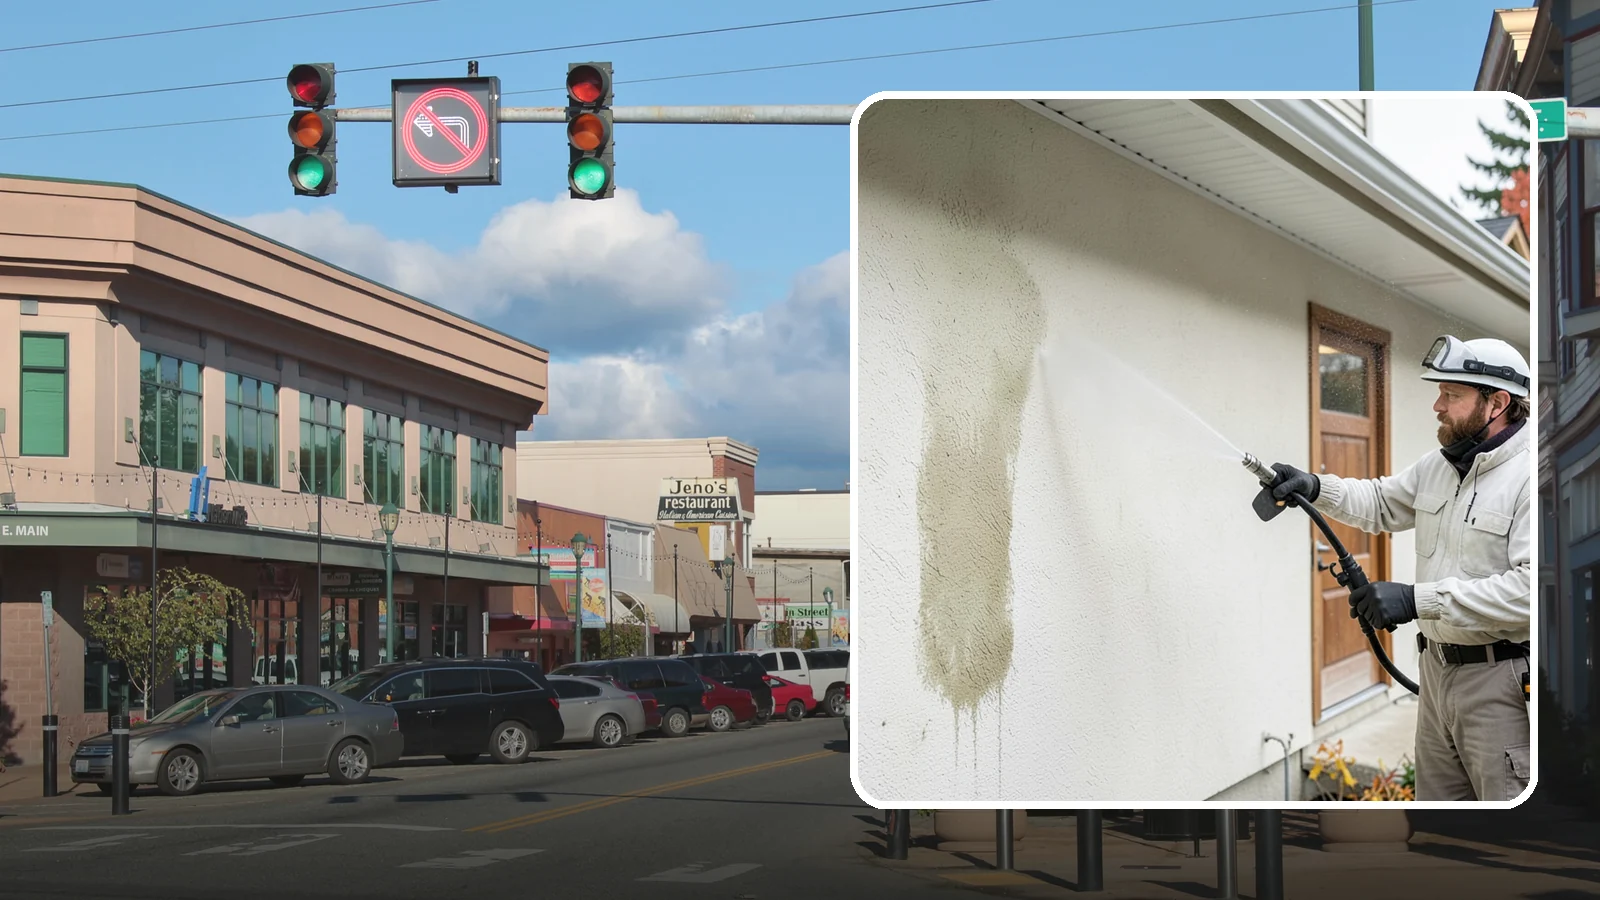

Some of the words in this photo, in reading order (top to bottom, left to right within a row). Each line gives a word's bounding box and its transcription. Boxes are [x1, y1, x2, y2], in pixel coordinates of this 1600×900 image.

[669, 479, 728, 495] Jeno's
[664, 496, 732, 509] restaurant
[658, 509, 681, 520] Italian
[685, 509, 714, 520] American
[714, 509, 738, 520] Cuisine
[2, 525, 13, 536] E.
[15, 525, 49, 537] MAIN
[797, 607, 829, 617] Street
